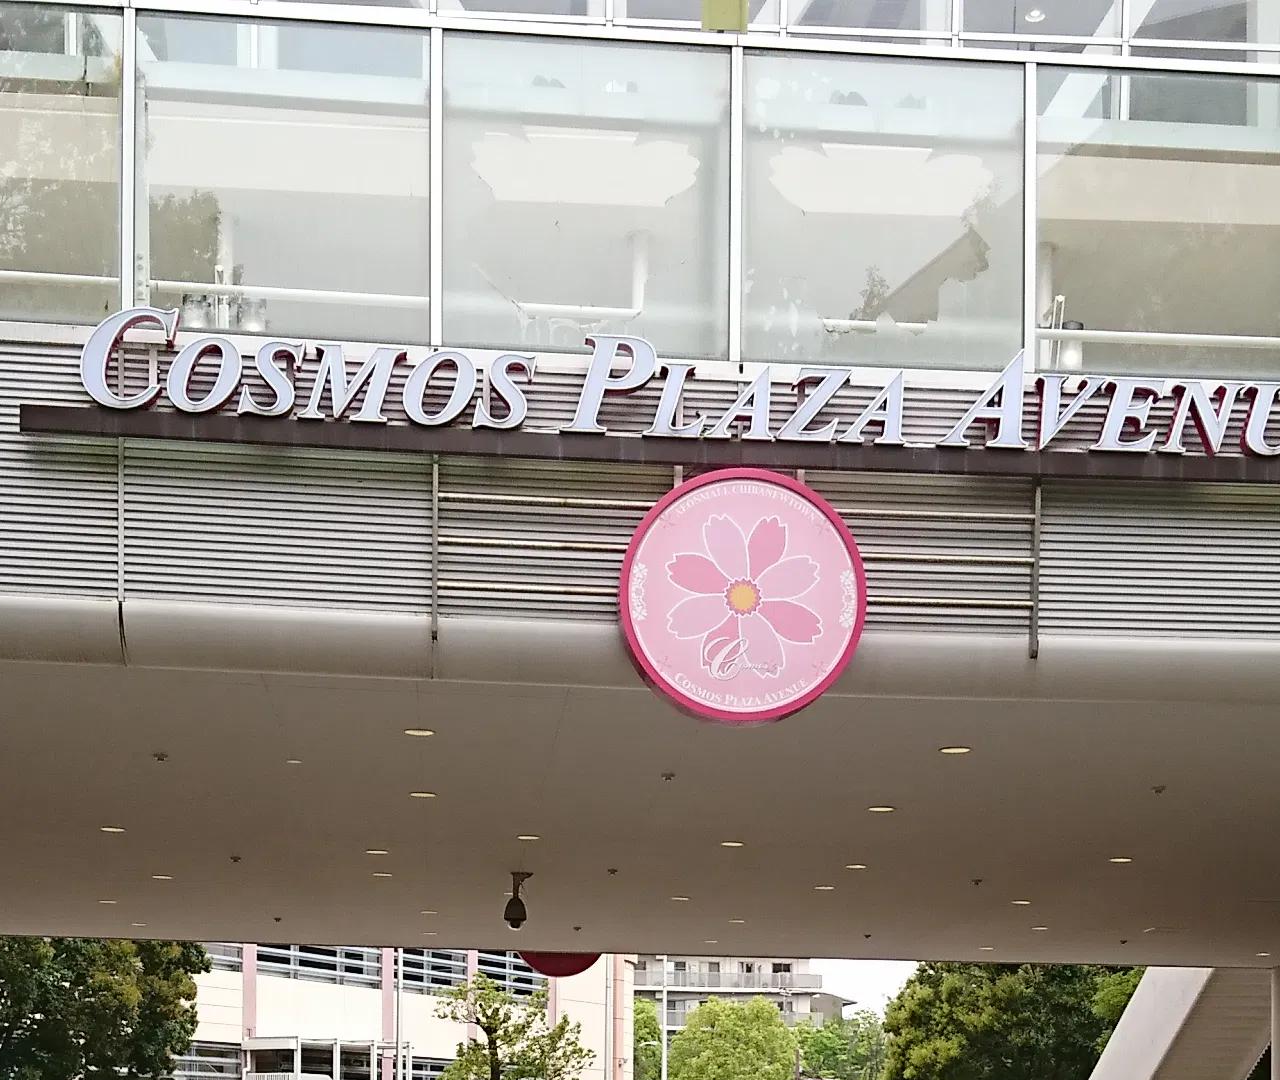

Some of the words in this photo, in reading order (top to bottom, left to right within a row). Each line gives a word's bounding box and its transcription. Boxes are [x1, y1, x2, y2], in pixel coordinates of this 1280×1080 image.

[79, 307, 537, 431] COSMOS
[558, 333, 906, 448] PLAZA
[674, 672, 723, 703] COSMOS
[723, 693, 762, 707] PLAZA
[763, 677, 809, 704] AVENUE
